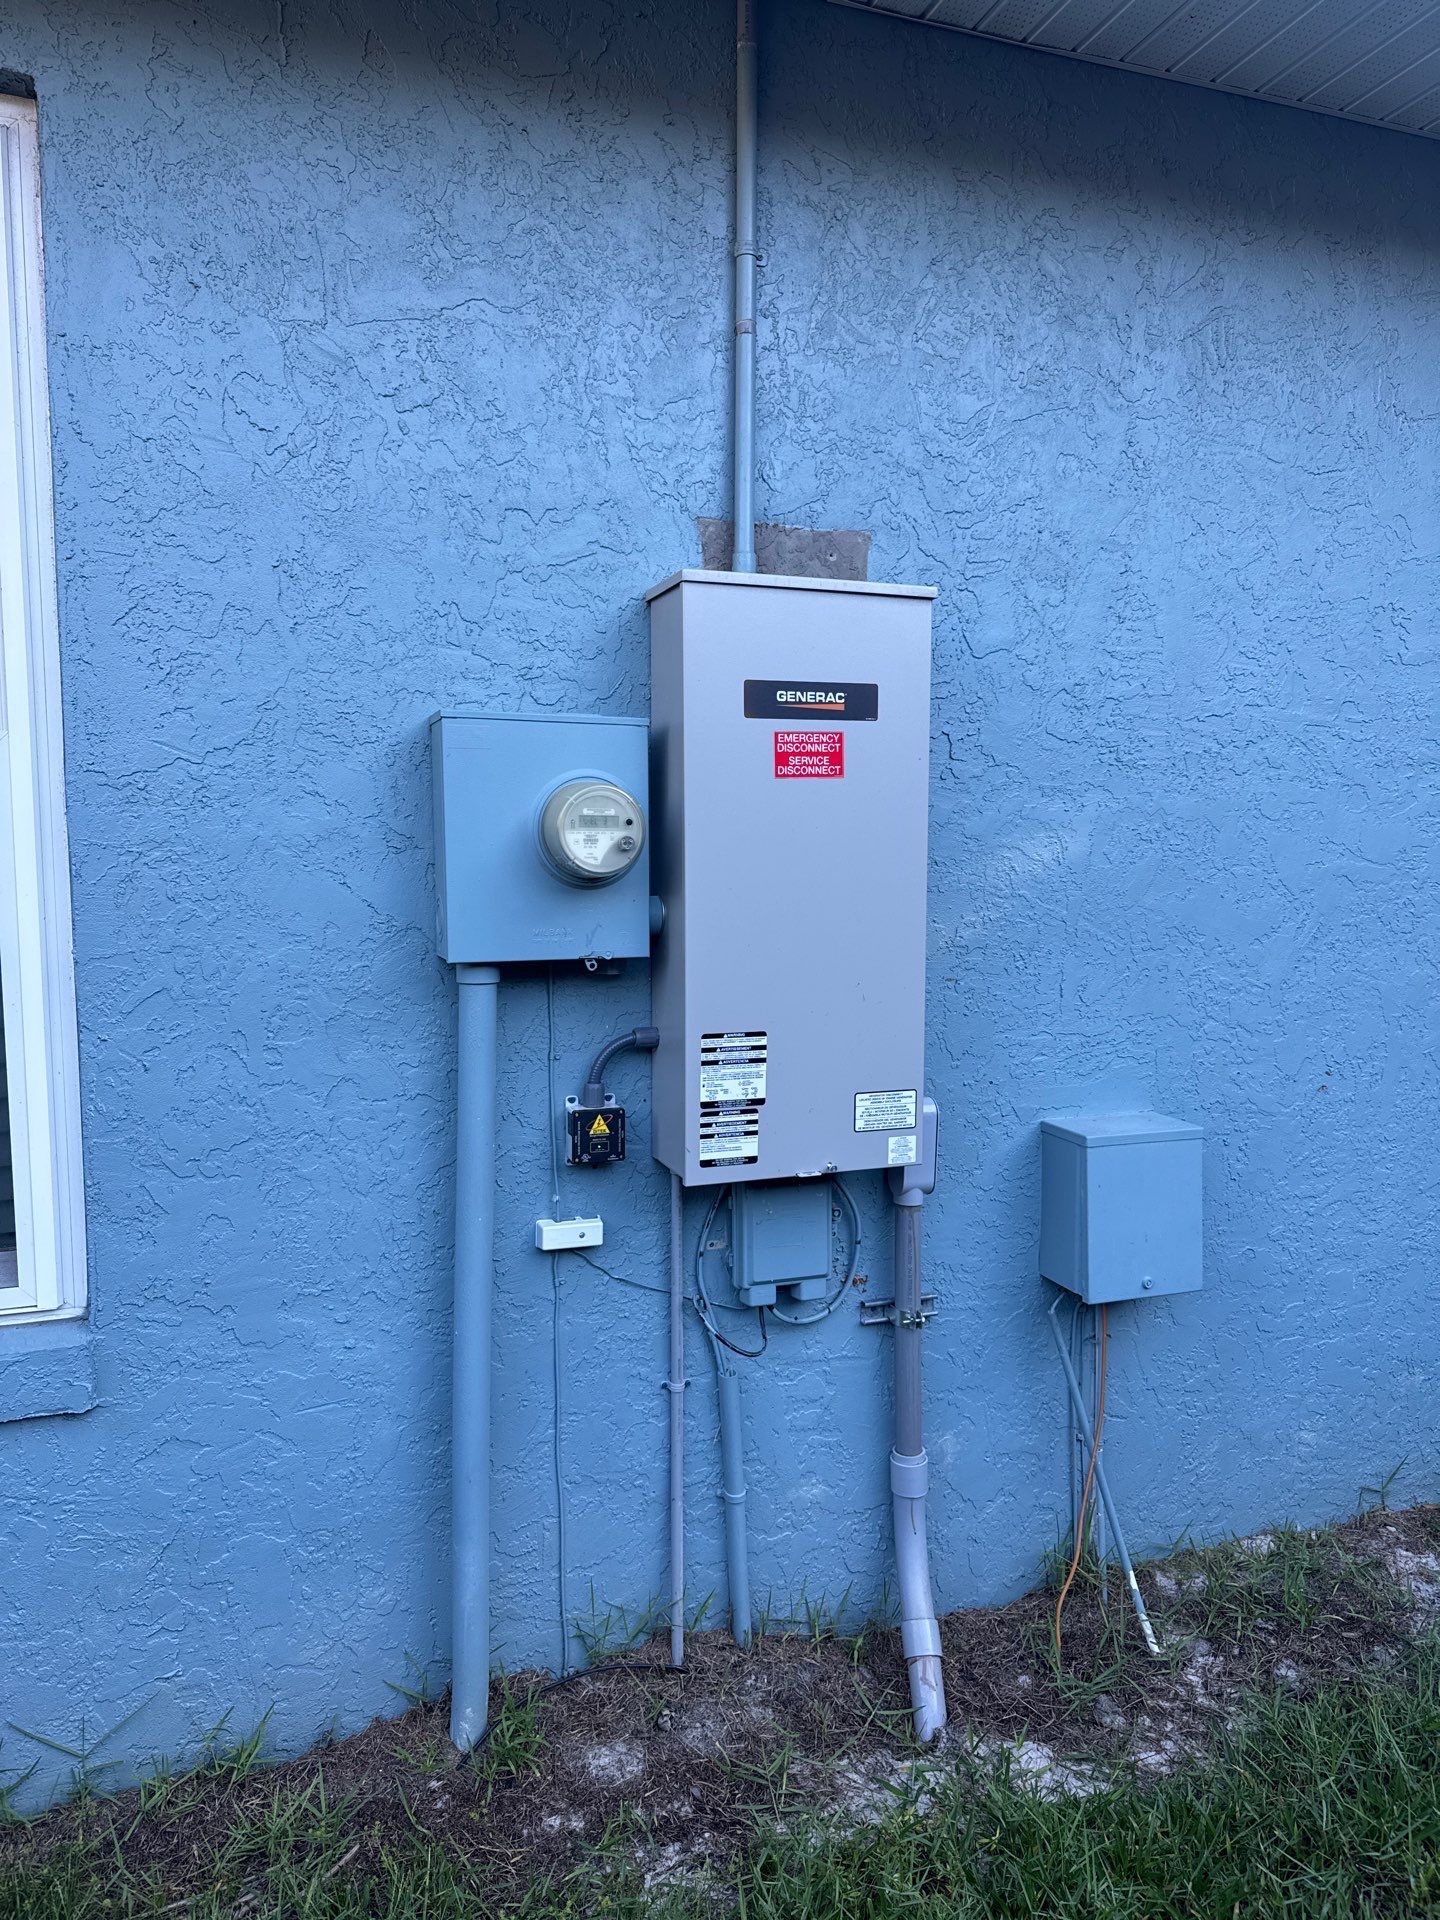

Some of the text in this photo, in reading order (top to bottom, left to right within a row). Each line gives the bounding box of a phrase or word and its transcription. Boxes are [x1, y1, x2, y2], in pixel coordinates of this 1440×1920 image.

[777, 691, 845, 703] GENERAC
[778, 734, 840, 743] EMERGENCY
[777, 743, 841, 753] DISCONNECT
[788, 756, 830, 765] SERVICE
[777, 765, 841, 775] DISCONNECT
